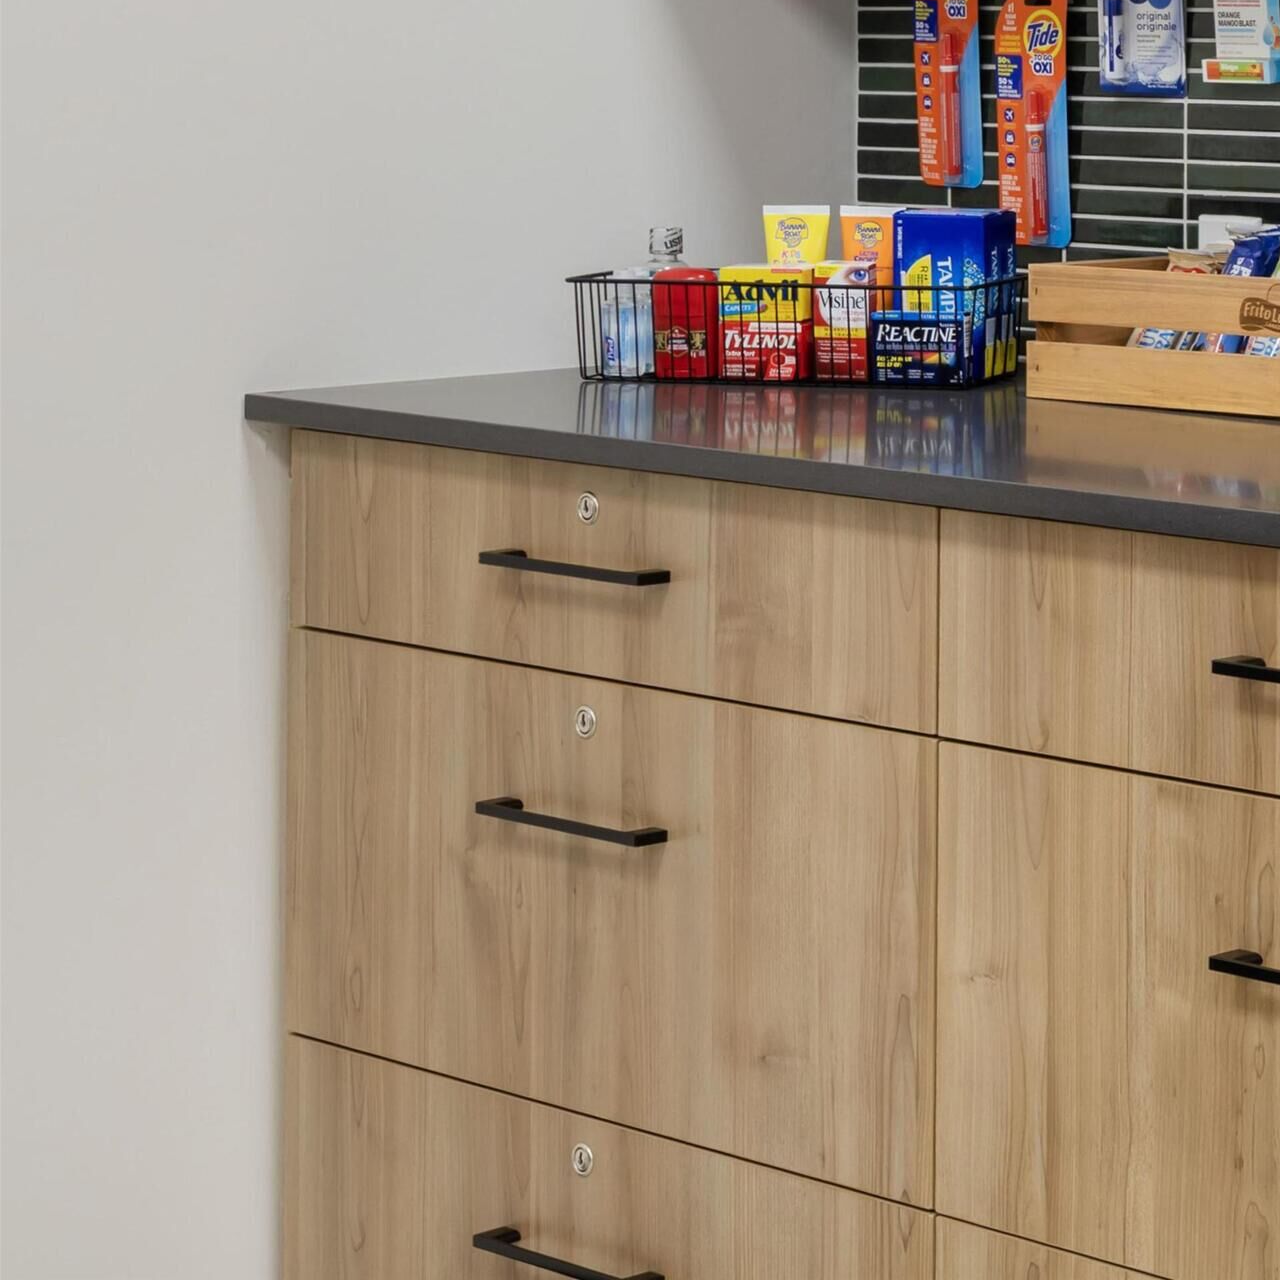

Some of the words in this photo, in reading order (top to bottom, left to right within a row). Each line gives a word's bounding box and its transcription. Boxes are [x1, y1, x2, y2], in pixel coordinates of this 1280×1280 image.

[948, 6, 966, 18] OXI
[1136, 11, 1171, 24] original
[1217, 11, 1241, 19] ORANGE
[1136, 21, 1177, 33] originale
[1028, 21, 1059, 52] Tide
[1033, 62, 1052, 74] OXI
[724, 279, 799, 303] Advil
[724, 329, 796, 349] TYLENOL
[876, 323, 957, 342] REACTINE
